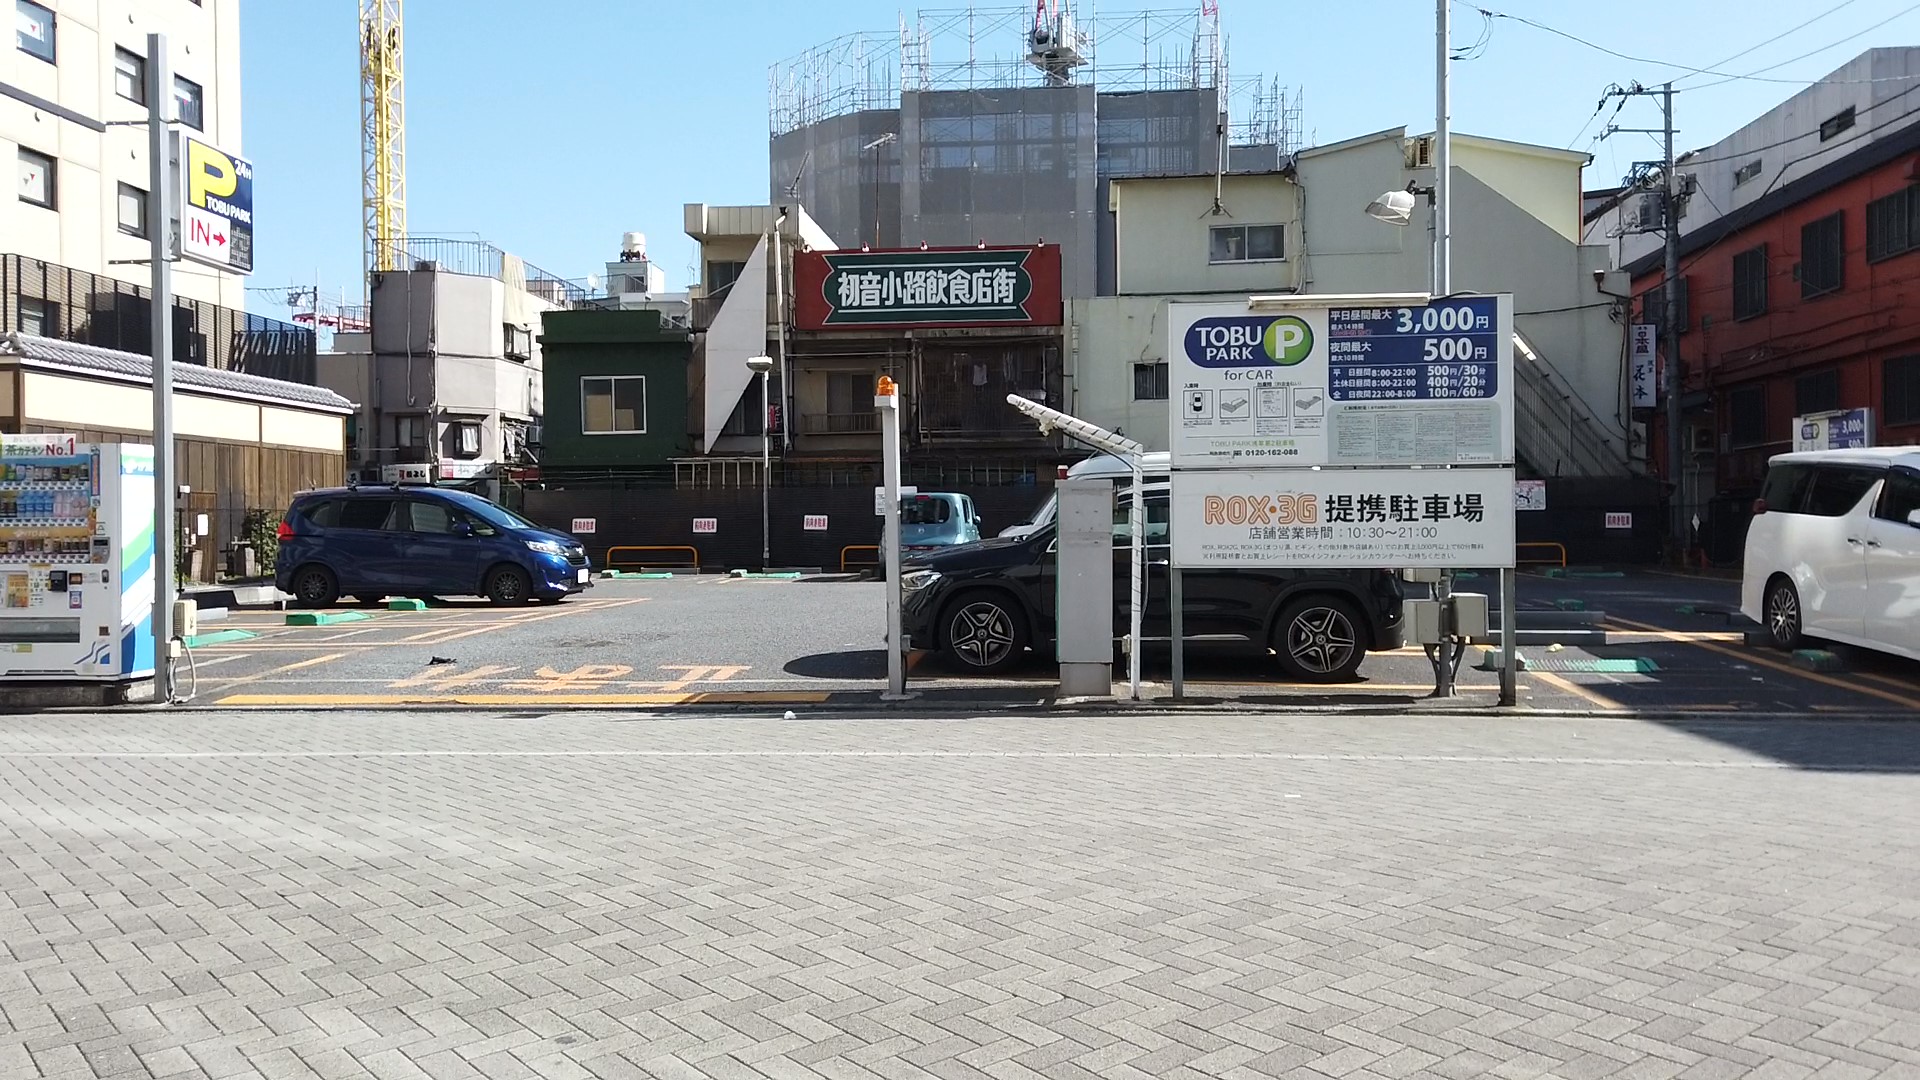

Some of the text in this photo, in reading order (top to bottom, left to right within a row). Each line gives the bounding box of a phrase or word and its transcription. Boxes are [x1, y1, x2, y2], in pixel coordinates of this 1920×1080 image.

[189, 139, 237, 208] P
[206, 195, 251, 224] TOBU PARK
[190, 217, 210, 247] IN
[837, 268, 1017, 307] 初音小路飲食店街
[1330, 306, 1489, 333] 平日昼間最大 3,000円
[1195, 324, 1304, 359] TOBU P
[1205, 346, 1254, 361] PARK
[1330, 337, 1488, 362] 夜間最大 500円
[1224, 369, 1274, 381] for CAR
[5, 444, 45, 456] 茶カテキン
[46, 437, 74, 456] No.1
[1325, 493, 1485, 523] 提携駐車場
